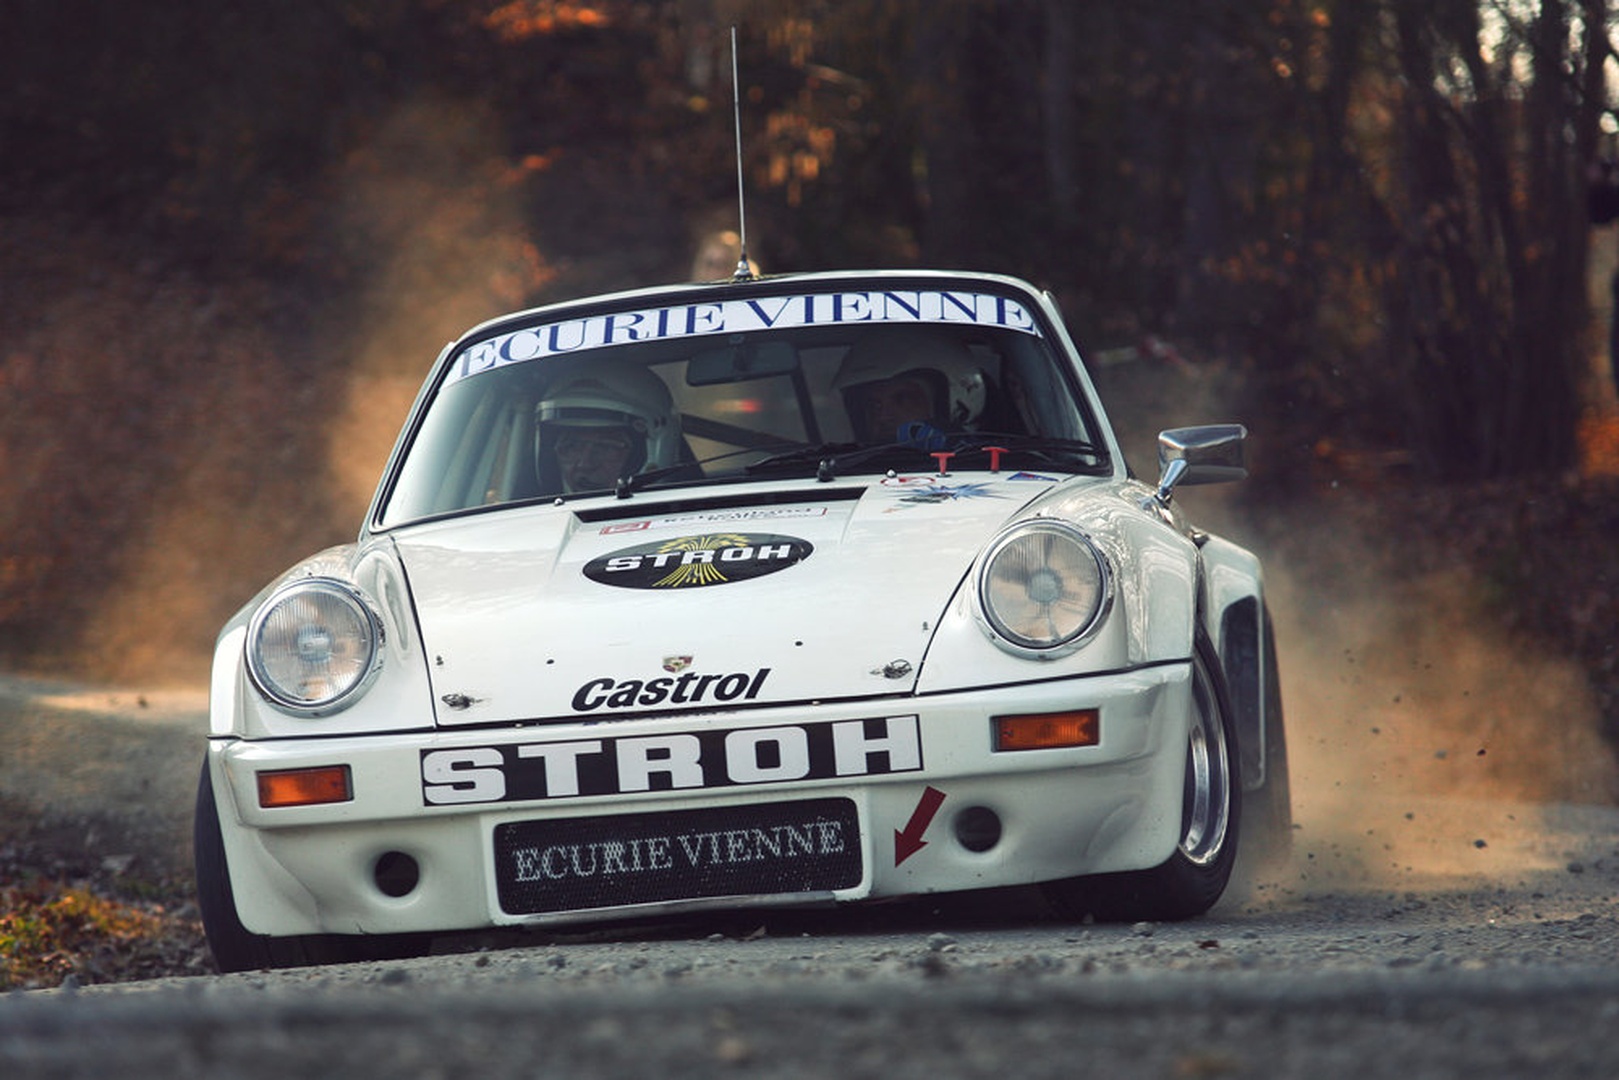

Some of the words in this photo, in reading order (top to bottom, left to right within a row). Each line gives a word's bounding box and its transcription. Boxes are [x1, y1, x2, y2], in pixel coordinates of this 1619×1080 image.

[461, 302, 725, 377] ECURIE
[744, 290, 1035, 331] VIENNE
[604, 544, 792, 573] STROH
[571, 668, 772, 711] Castrol
[422, 714, 922, 804] STROH
[514, 836, 674, 882] ECURIE
[677, 819, 845, 866] VIENNE
